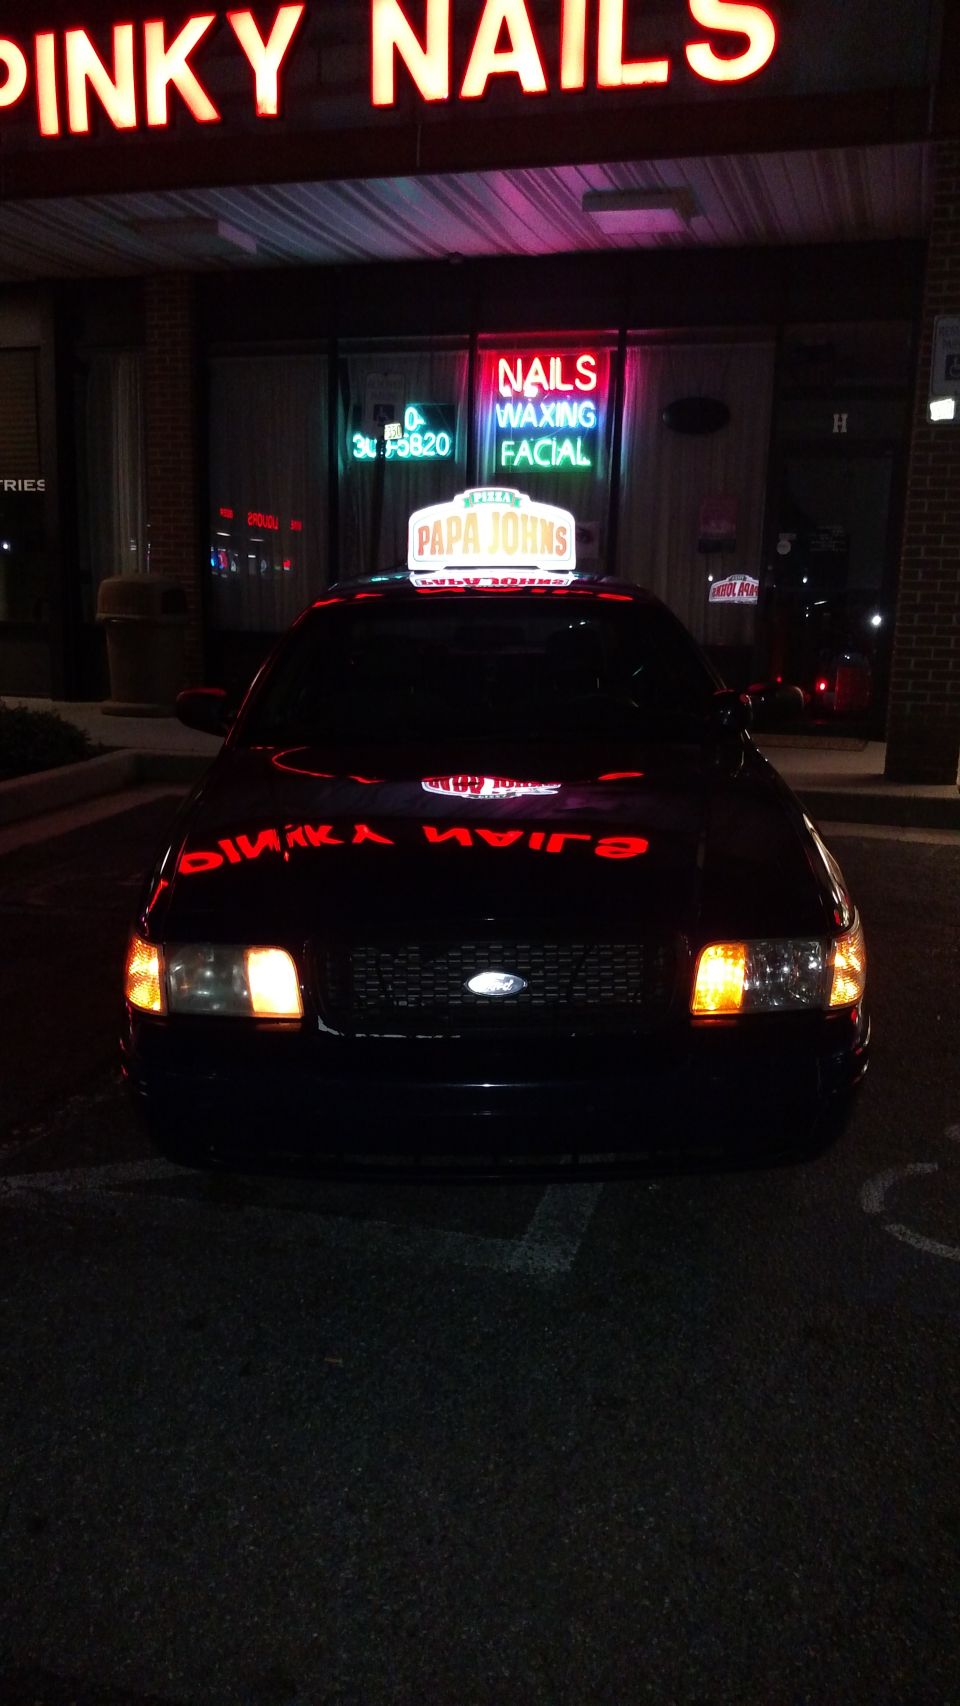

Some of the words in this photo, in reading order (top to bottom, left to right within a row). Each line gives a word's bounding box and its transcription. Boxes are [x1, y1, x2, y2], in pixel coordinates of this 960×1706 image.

[370, 0, 776, 107] NAILS
[498, 355, 597, 395] NAILS
[496, 401, 596, 429] WAXING
[833, 413, 847, 433] H
[501, 438, 591, 467] FACIAL
[0, 479, 46, 491] RIES
[472, 491, 512, 504] PIZZA
[417, 512, 481, 556] PAPA
[488, 511, 568, 556] JOHNS
